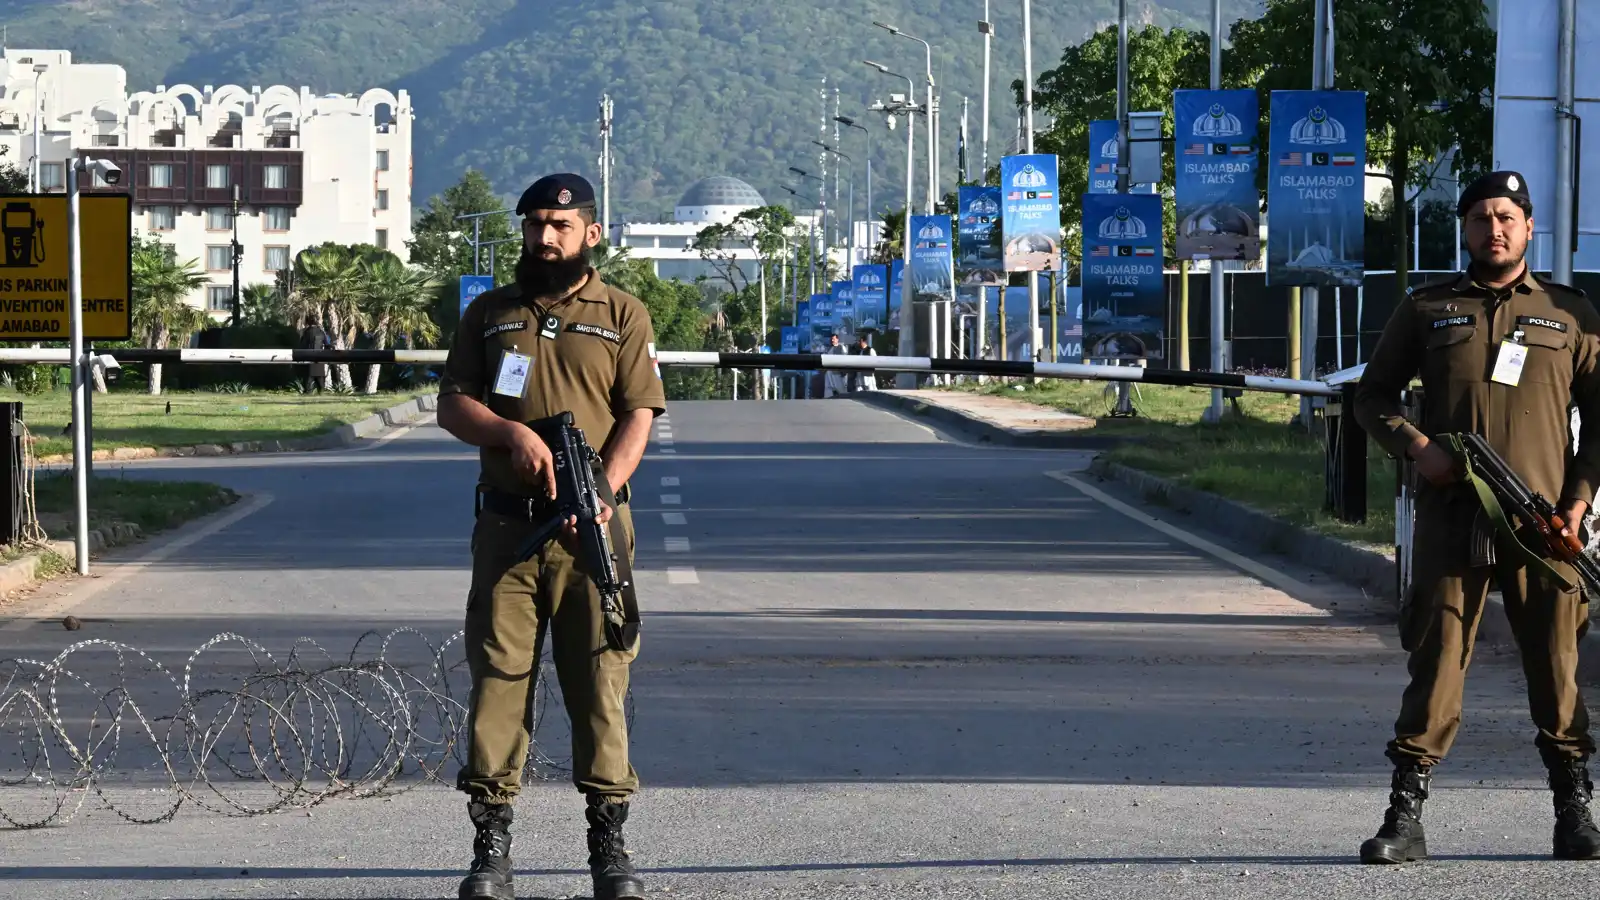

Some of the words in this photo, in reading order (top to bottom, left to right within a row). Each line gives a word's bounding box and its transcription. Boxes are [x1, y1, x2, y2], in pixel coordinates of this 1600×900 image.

[1185, 163, 1250, 173] ISLAMABAD
[1200, 174, 1235, 184] TALKS
[1280, 175, 1355, 187] ISLAMABAD
[1297, 188, 1337, 200] TALKS
[1090, 264, 1154, 274] ISLAMABAD
[16, 278, 68, 292] PARKIN
[1105, 275, 1139, 285] TALKS
[0, 299, 65, 312] VENTION
[81, 299, 124, 312] ENTRE
[0, 319, 60, 333] AMABAD
[1448, 316, 1468, 325] WAQAS
[1529, 318, 1561, 330] POLICE
[498, 322, 524, 332] NAWAZ
